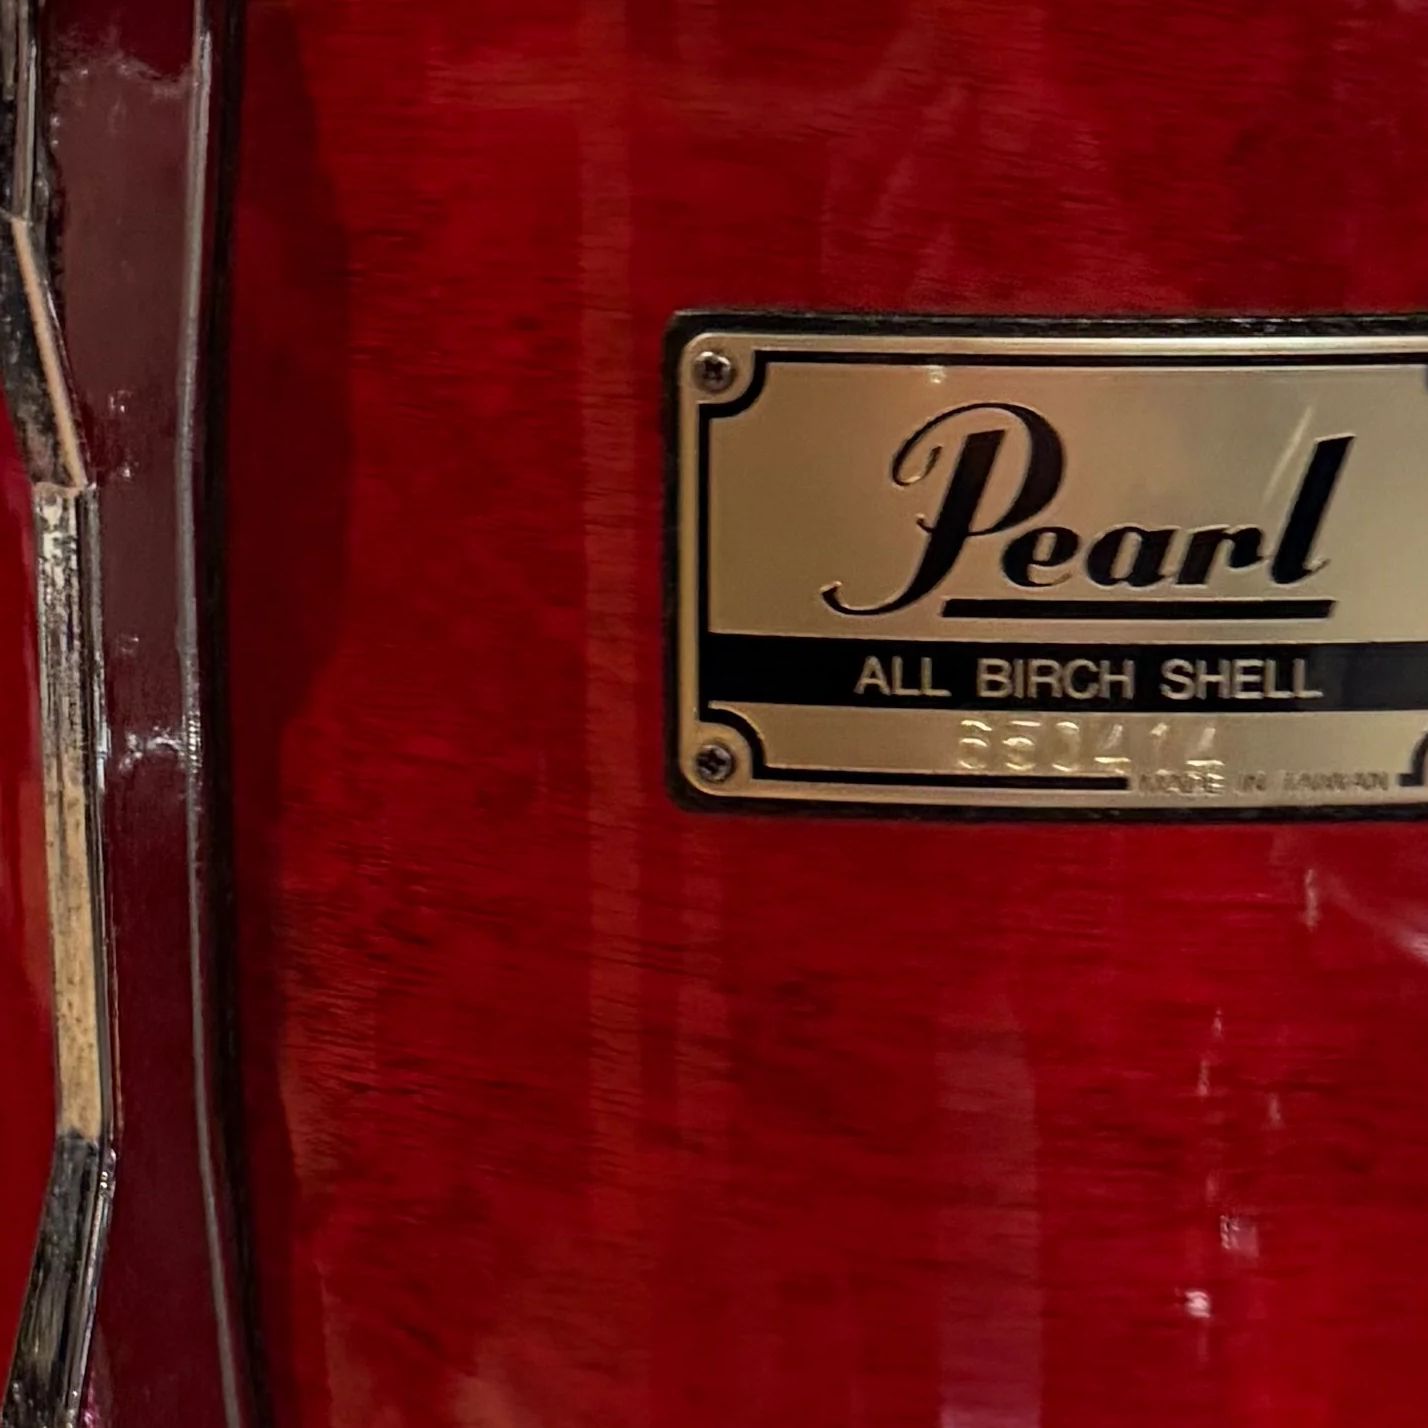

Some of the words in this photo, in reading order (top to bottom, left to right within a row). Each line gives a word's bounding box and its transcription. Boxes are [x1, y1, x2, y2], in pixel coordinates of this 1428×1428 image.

[820, 401, 1358, 618] Pearl
[853, 655, 953, 698] ALL
[975, 657, 1135, 701] BIRCH
[1158, 658, 1324, 701] SHELL
